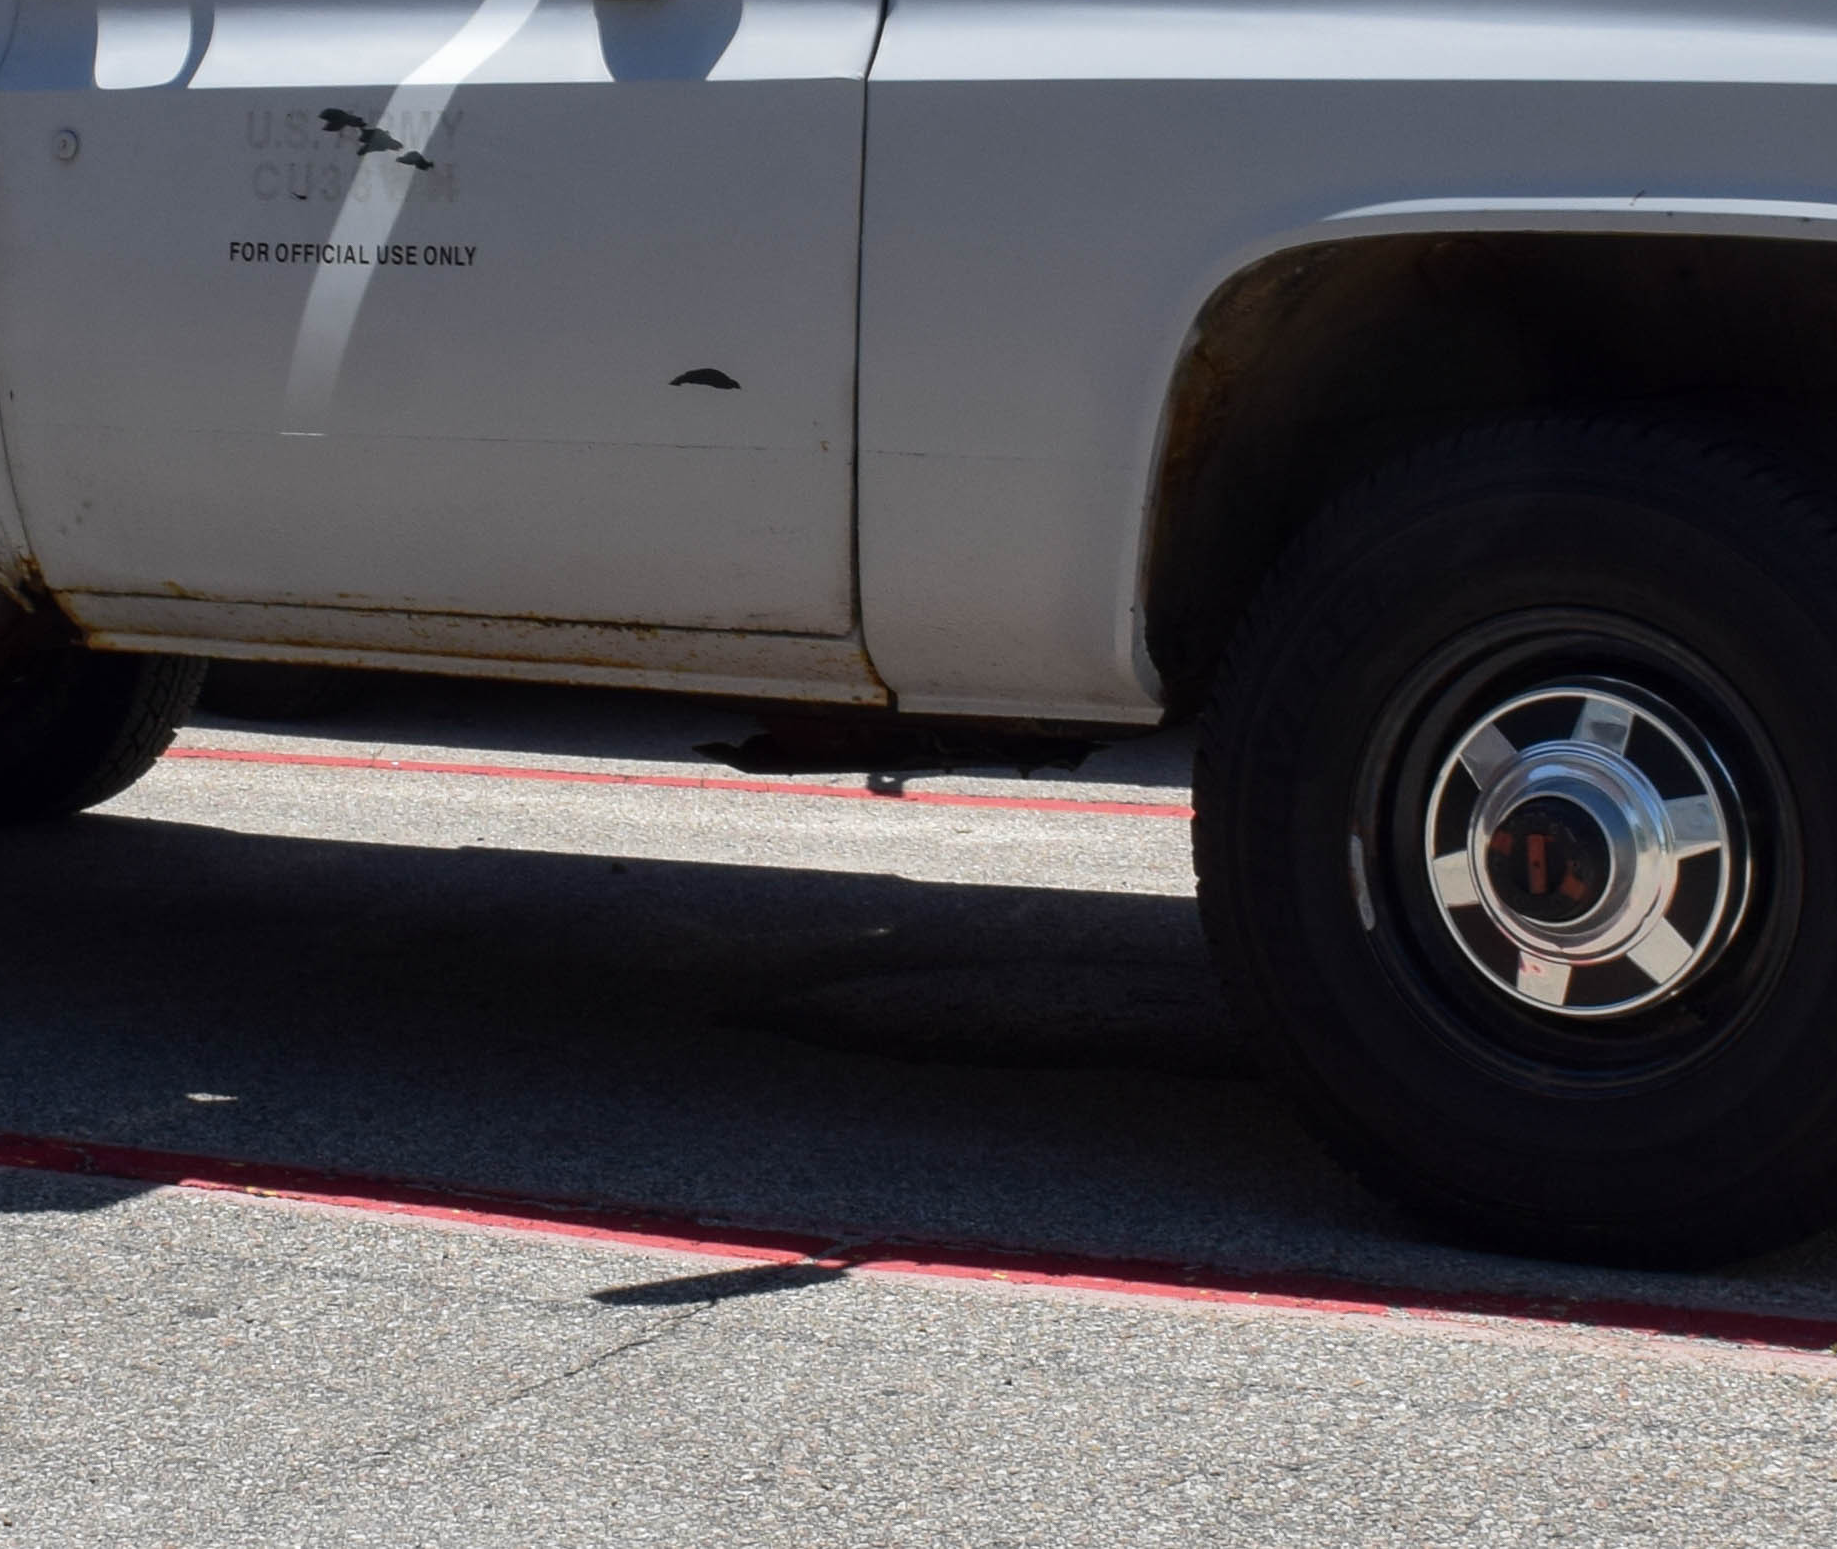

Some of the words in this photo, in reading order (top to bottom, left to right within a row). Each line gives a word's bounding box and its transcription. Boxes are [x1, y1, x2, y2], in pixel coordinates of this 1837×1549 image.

[229, 242, 269, 262] FOR
[275, 243, 370, 265] OFFICIAL
[376, 245, 418, 266] USE
[423, 246, 477, 267] ONLY
